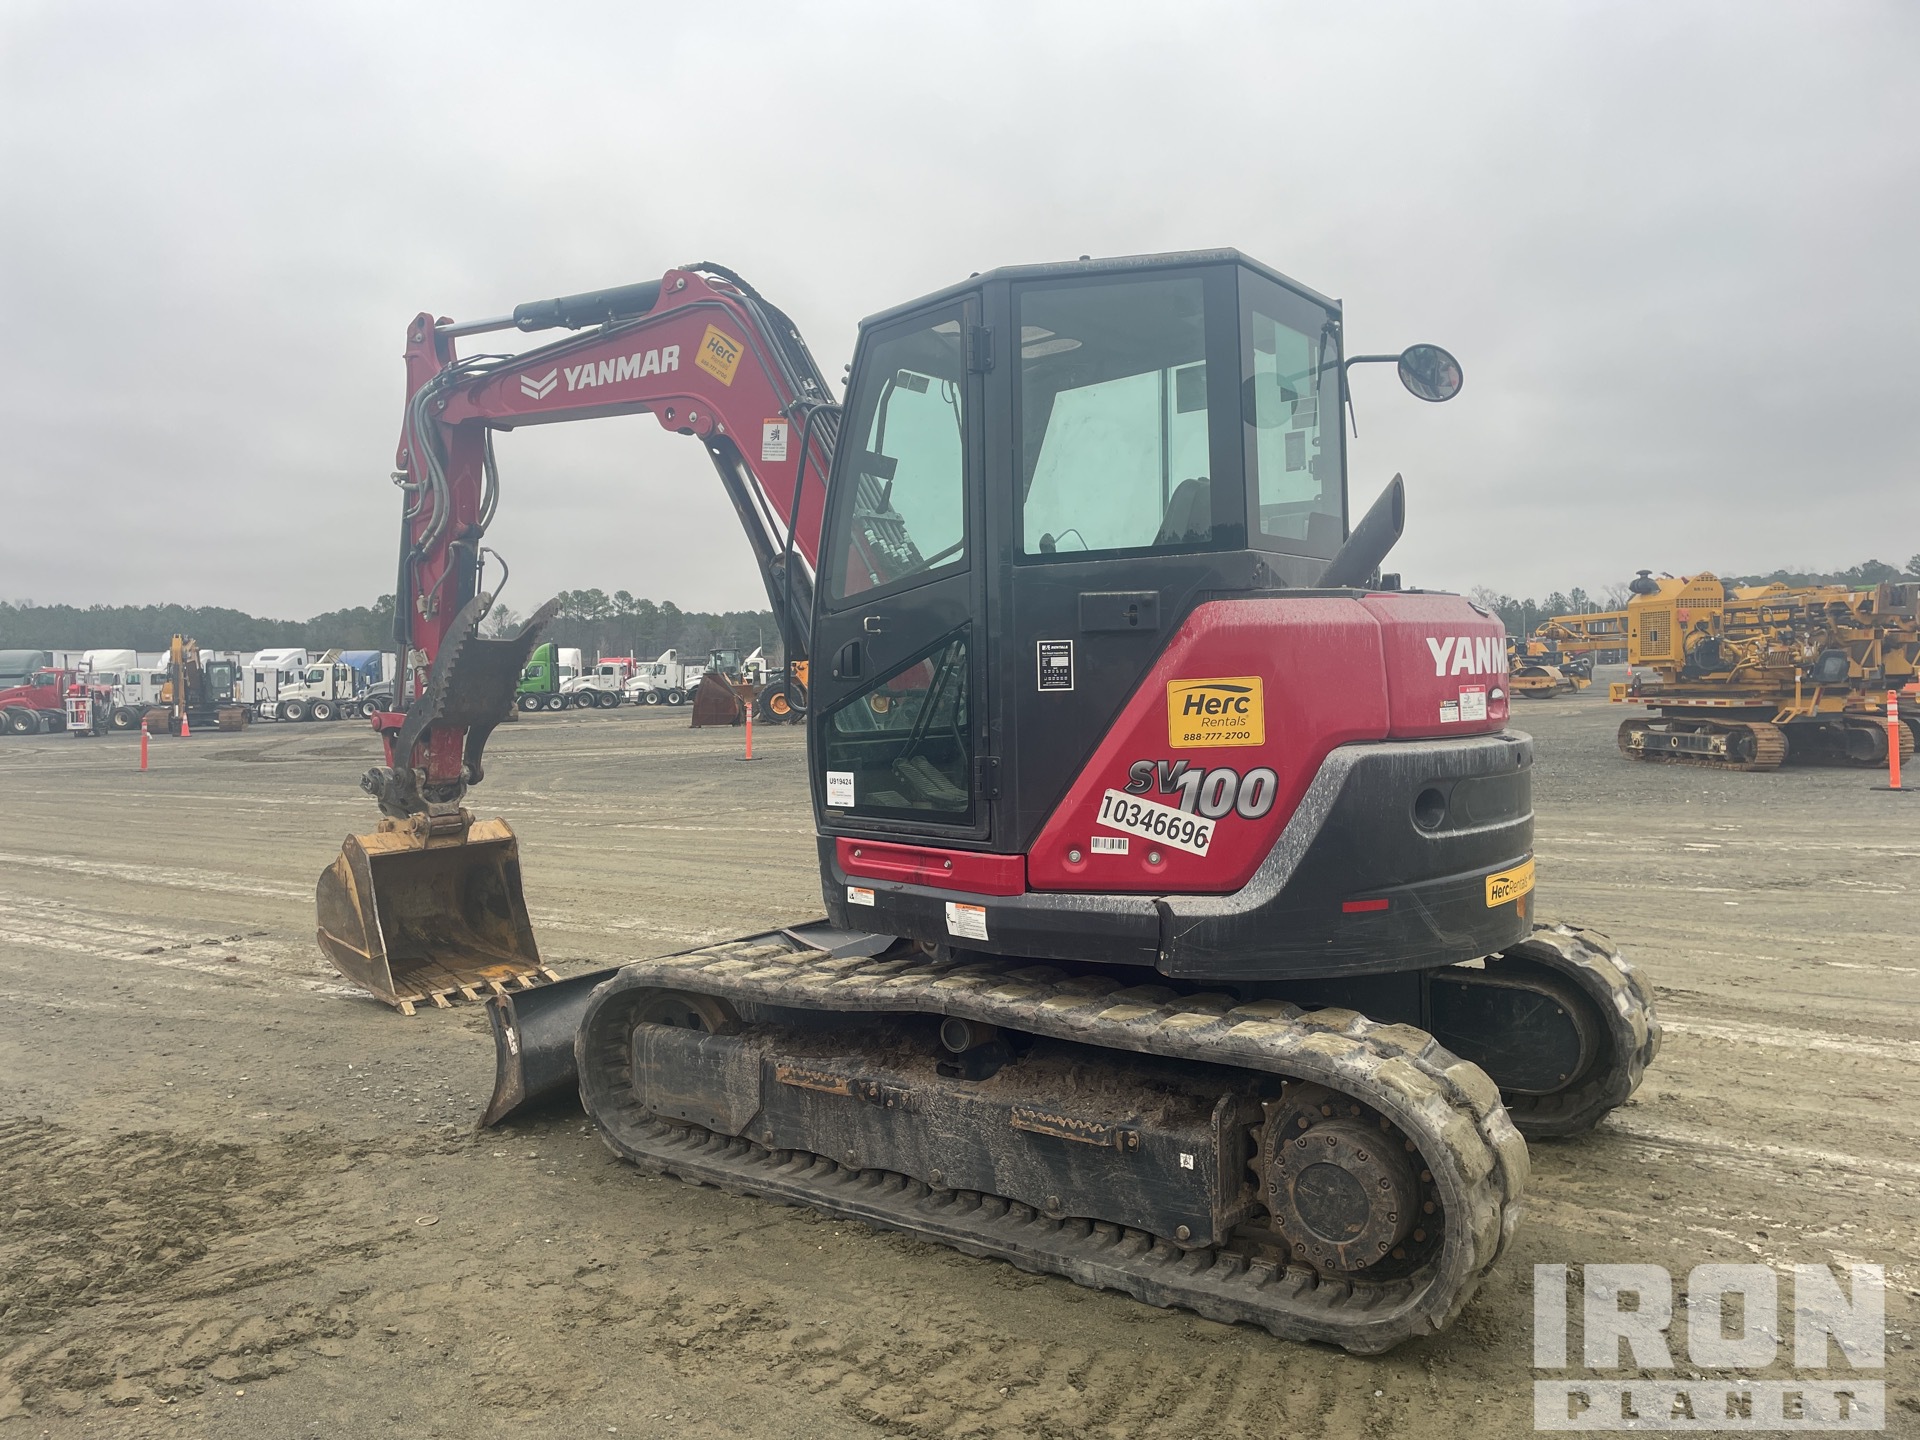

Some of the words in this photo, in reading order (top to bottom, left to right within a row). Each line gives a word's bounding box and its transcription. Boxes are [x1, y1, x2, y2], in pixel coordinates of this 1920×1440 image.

[706, 337, 735, 364] Herc
[563, 344, 680, 391] YANMAR
[1426, 636, 1508, 676] YANM
[1182, 694, 1251, 716] Herc
[1201, 715, 1247, 728] Rentals
[1183, 731, 1251, 741] 888-777-2700
[829, 777, 852, 785] U919424
[1123, 759, 1279, 821] SV100
[1102, 795, 1209, 849] 10346696
